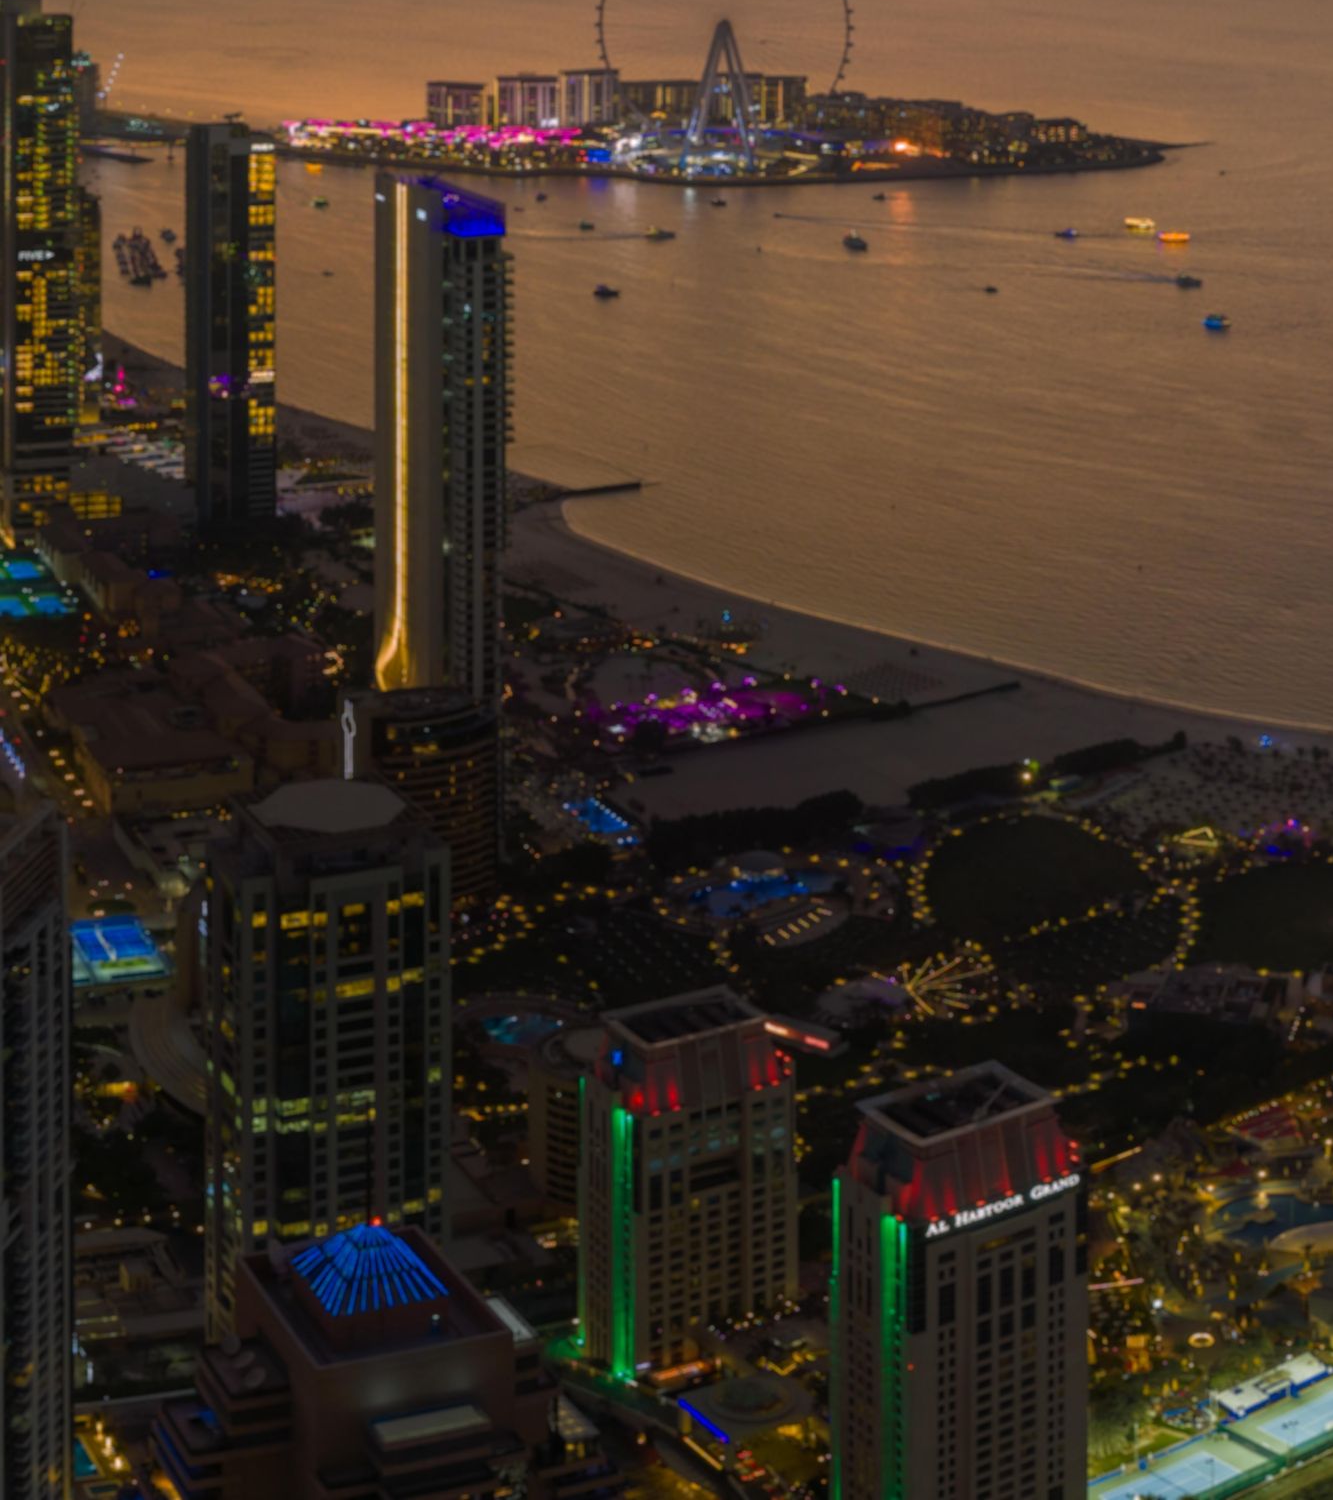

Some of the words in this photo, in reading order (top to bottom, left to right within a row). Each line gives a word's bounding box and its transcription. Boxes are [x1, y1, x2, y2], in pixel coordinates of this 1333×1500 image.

[925, 1220, 949, 1238] AL
[955, 1194, 1024, 1228] HABTOOR
[1029, 1173, 1080, 1200] GRAND
